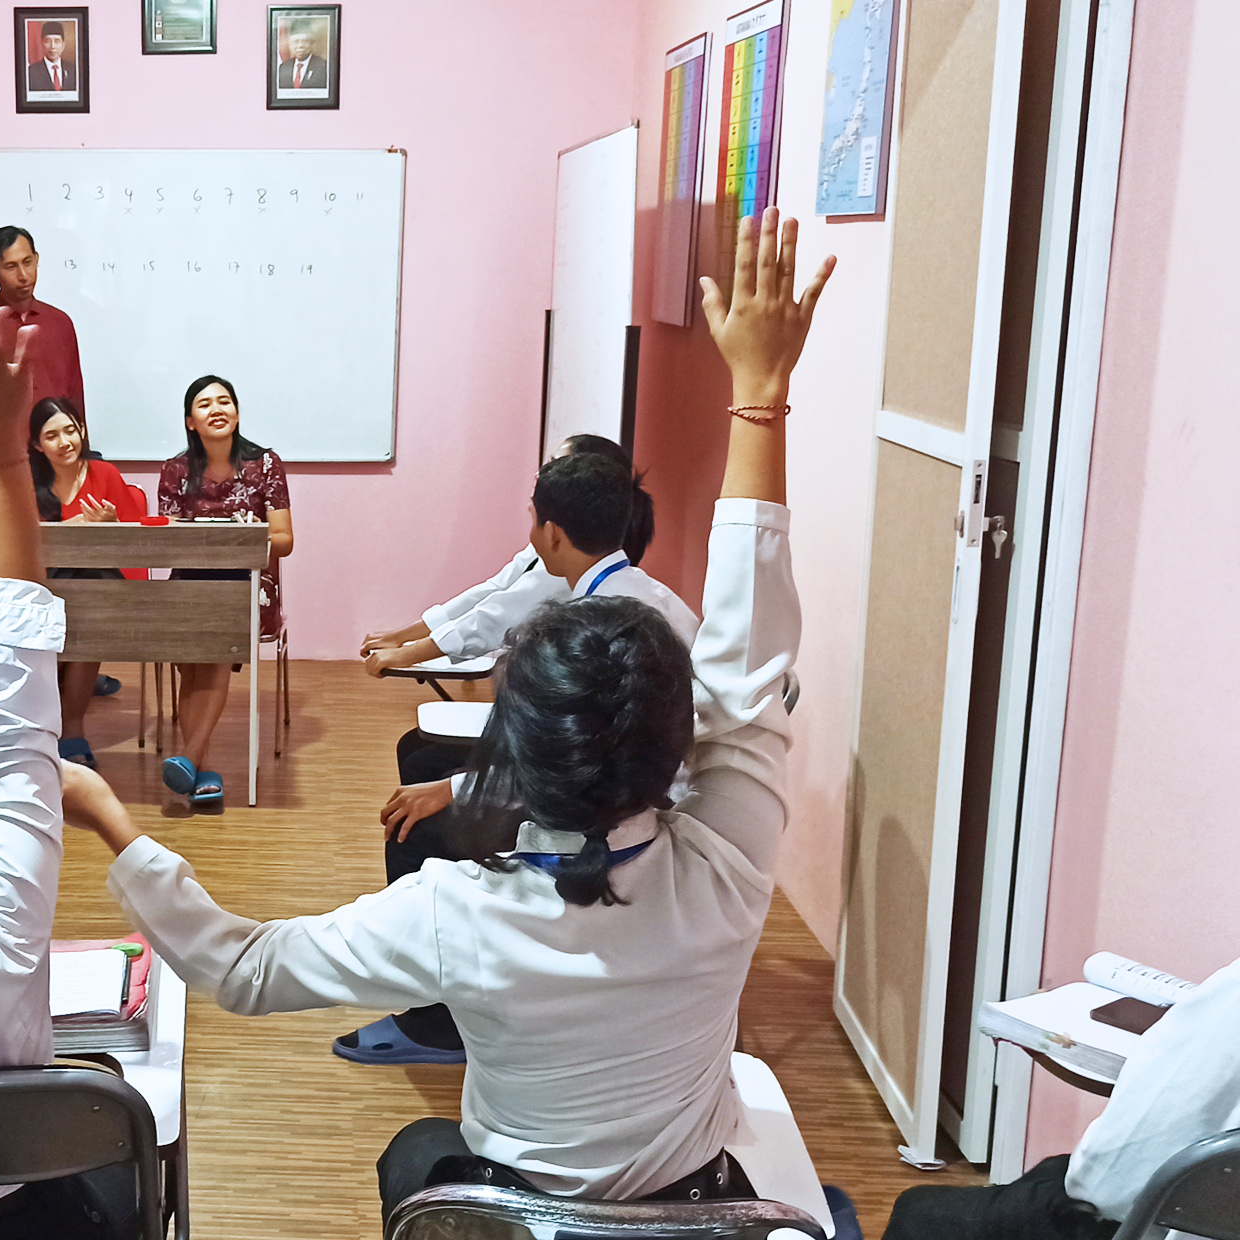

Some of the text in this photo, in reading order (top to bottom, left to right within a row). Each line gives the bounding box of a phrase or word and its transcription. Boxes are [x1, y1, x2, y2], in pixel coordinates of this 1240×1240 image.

[61, 182, 72, 201] 2
[95, 184, 106, 201] 3
[123, 188, 134, 203] 4
[155, 186, 165, 202] 5
[192, 187, 203, 202] 6
[224, 186, 234, 204] 7
[256, 187, 267, 204] 8
[289, 188, 299, 203] 9
[323, 191, 337, 203] 10
[63, 259, 314, 276] 13 14 15 16 17 18 19
